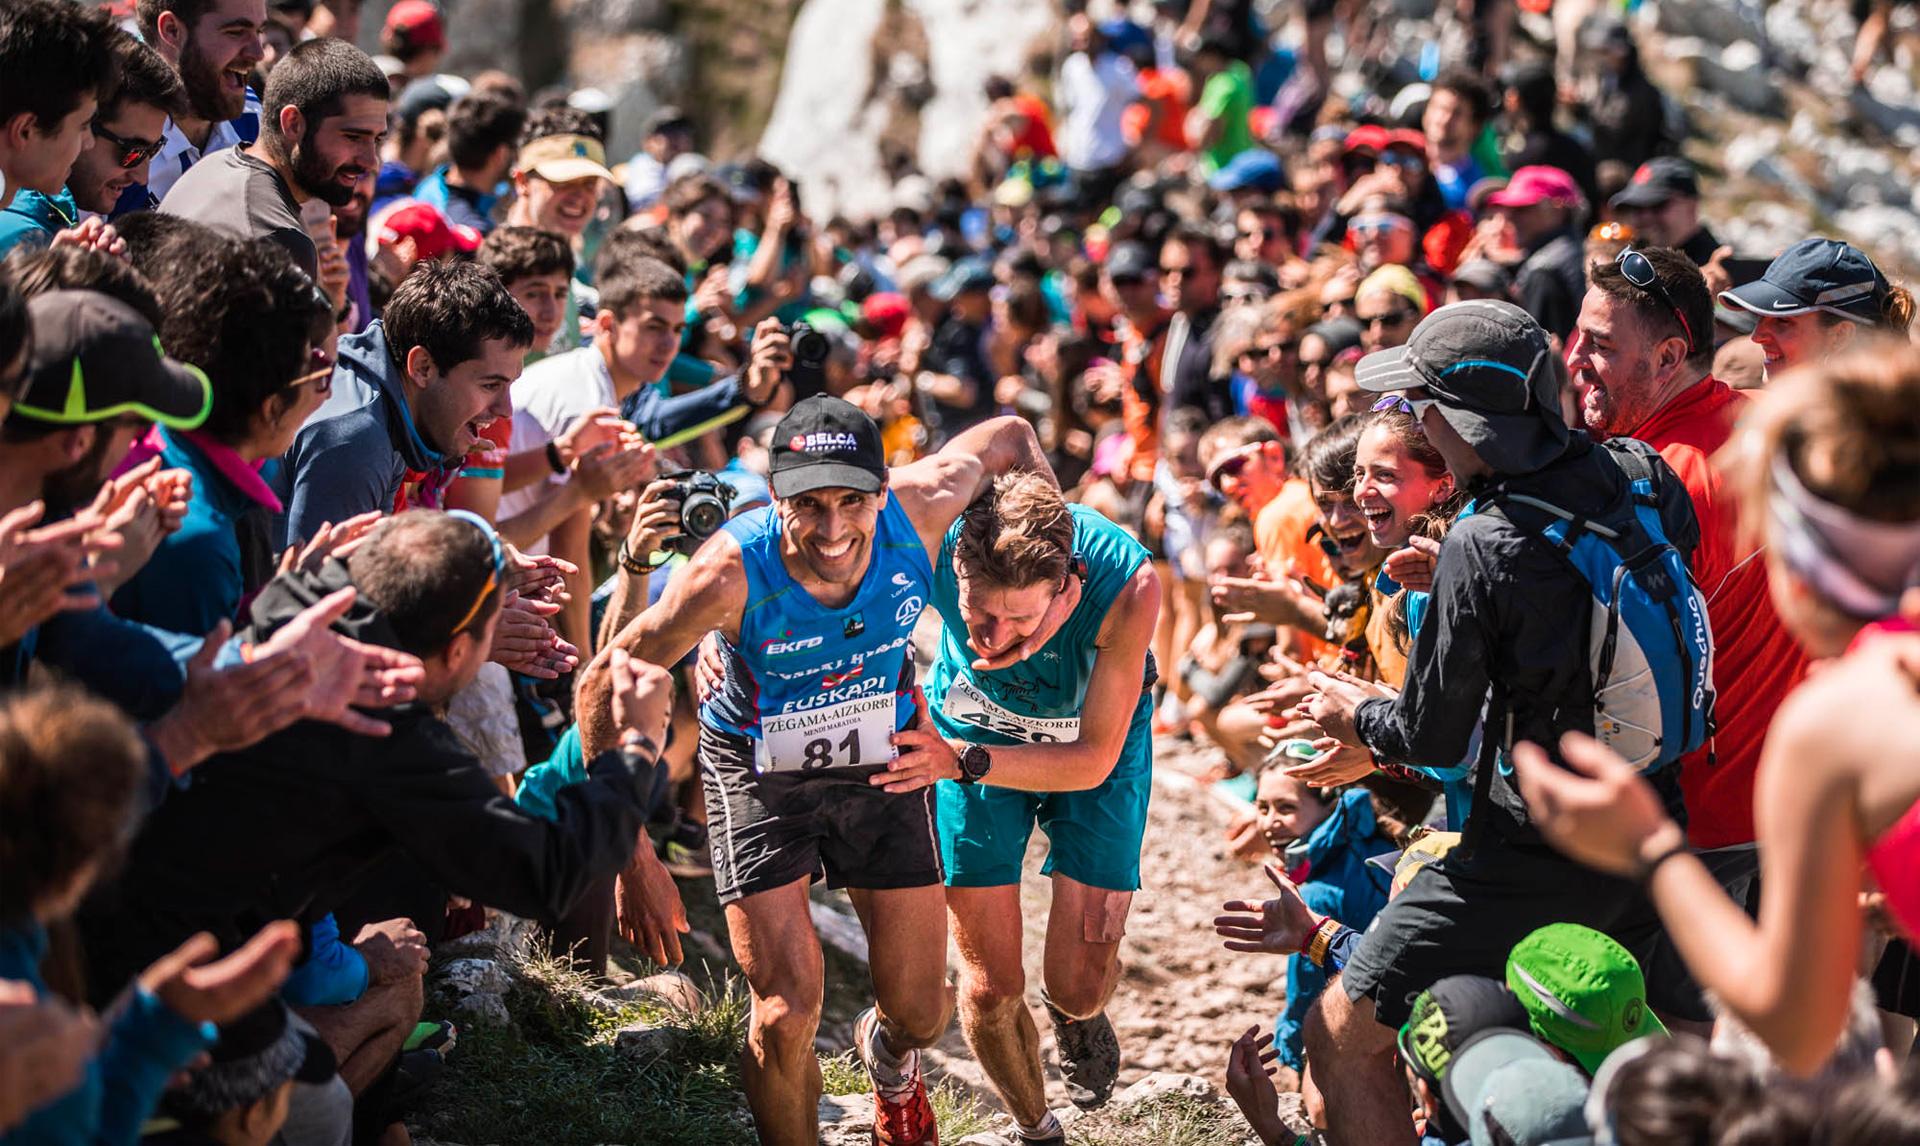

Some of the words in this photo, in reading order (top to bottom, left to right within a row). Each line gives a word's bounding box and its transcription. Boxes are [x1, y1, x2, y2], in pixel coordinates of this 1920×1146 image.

[806, 432, 857, 447] BELCA
[1687, 595, 1708, 710] Quechua
[782, 676, 886, 714] EUSKADI
[768, 697, 894, 734] ZEGAMA-AIZKORRI
[801, 728, 861, 770] 81
